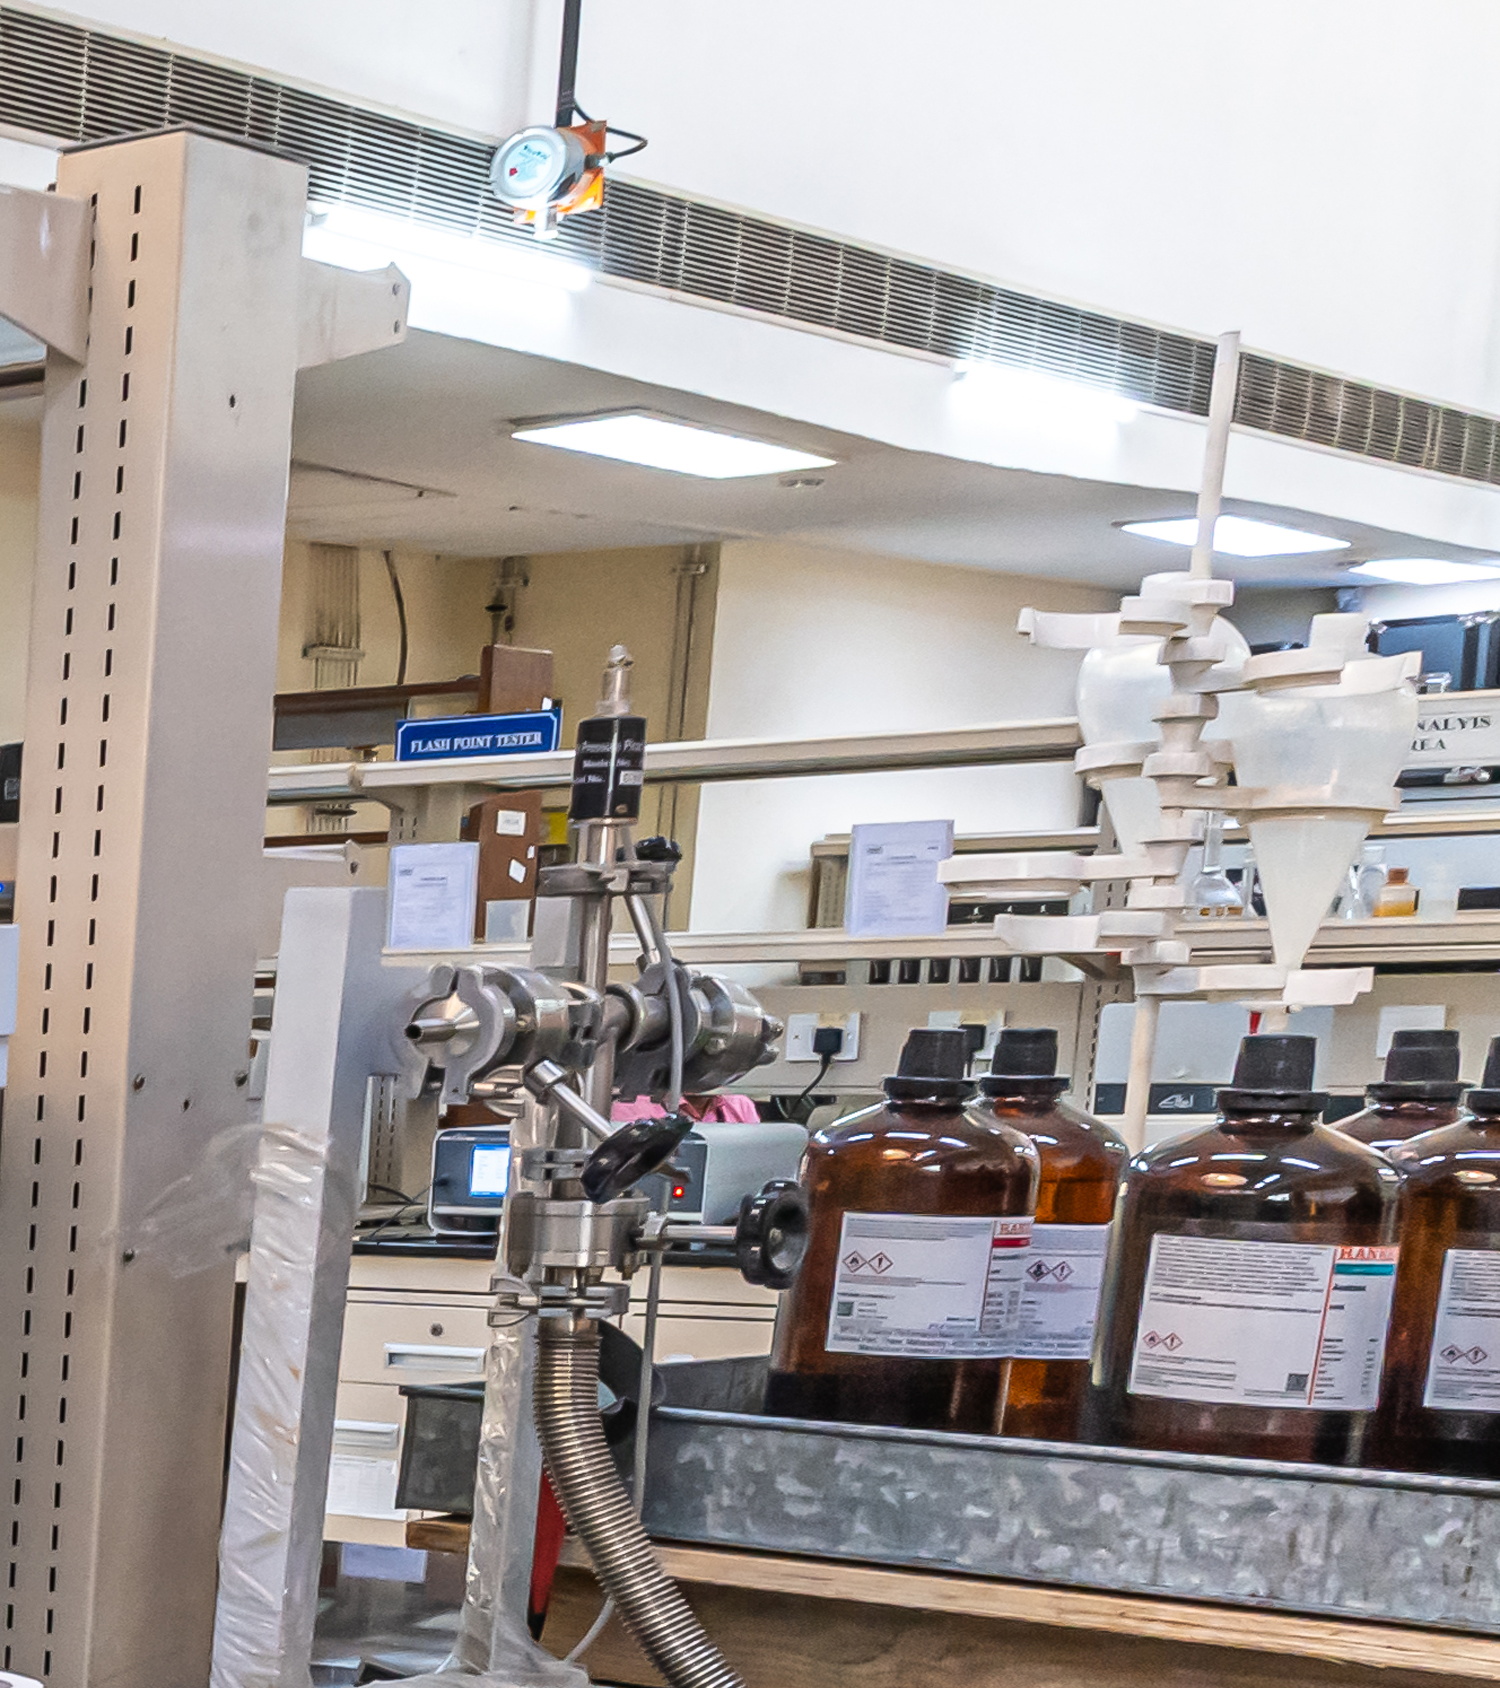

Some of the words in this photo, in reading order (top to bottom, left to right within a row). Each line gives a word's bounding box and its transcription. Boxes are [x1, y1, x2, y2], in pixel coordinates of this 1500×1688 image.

[1416, 716, 1492, 731] NALYIS
[410, 738, 451, 754] FLASH
[453, 735, 494, 751] POINT
[495, 731, 543, 748] TESTER
